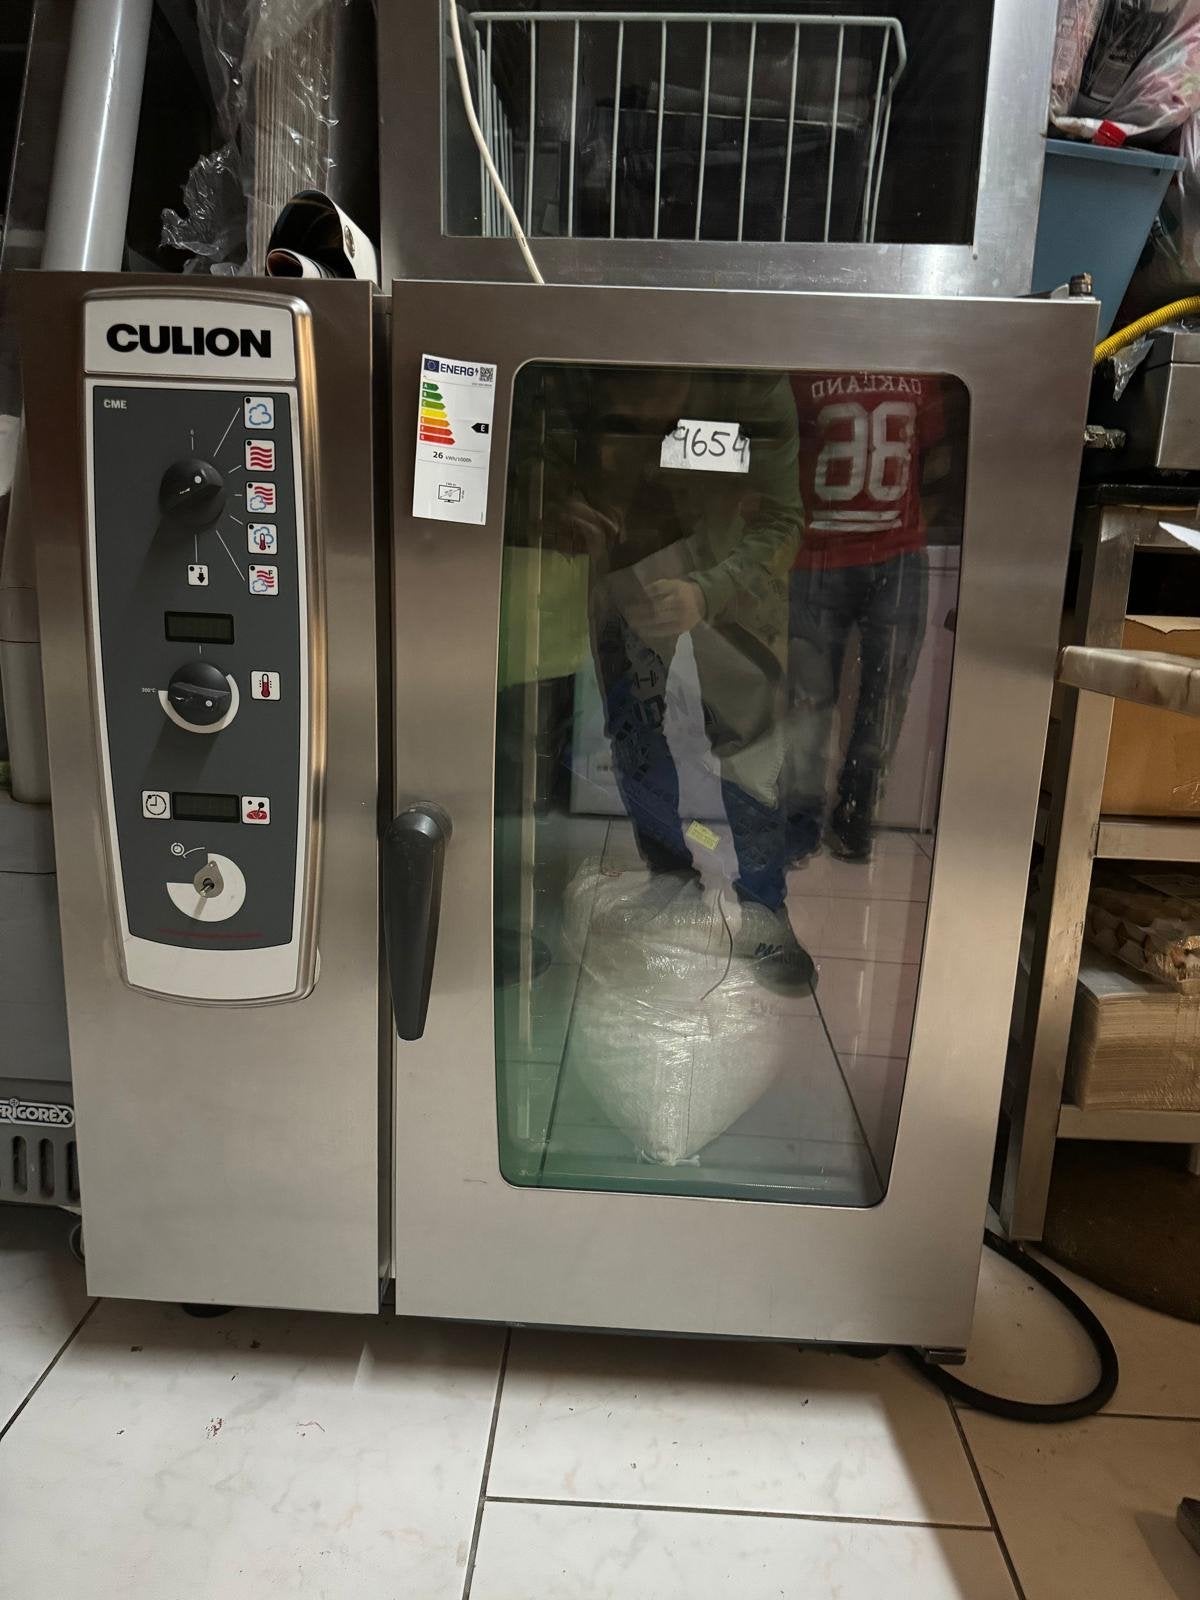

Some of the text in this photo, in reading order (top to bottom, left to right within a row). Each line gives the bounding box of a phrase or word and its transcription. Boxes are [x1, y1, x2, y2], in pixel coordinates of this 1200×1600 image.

[106, 323, 272, 358] CULION
[440, 364, 474, 377] ENERG
[103, 399, 127, 409] CME
[673, 426, 748, 463] 9654
[432, 451, 444, 459] 26
